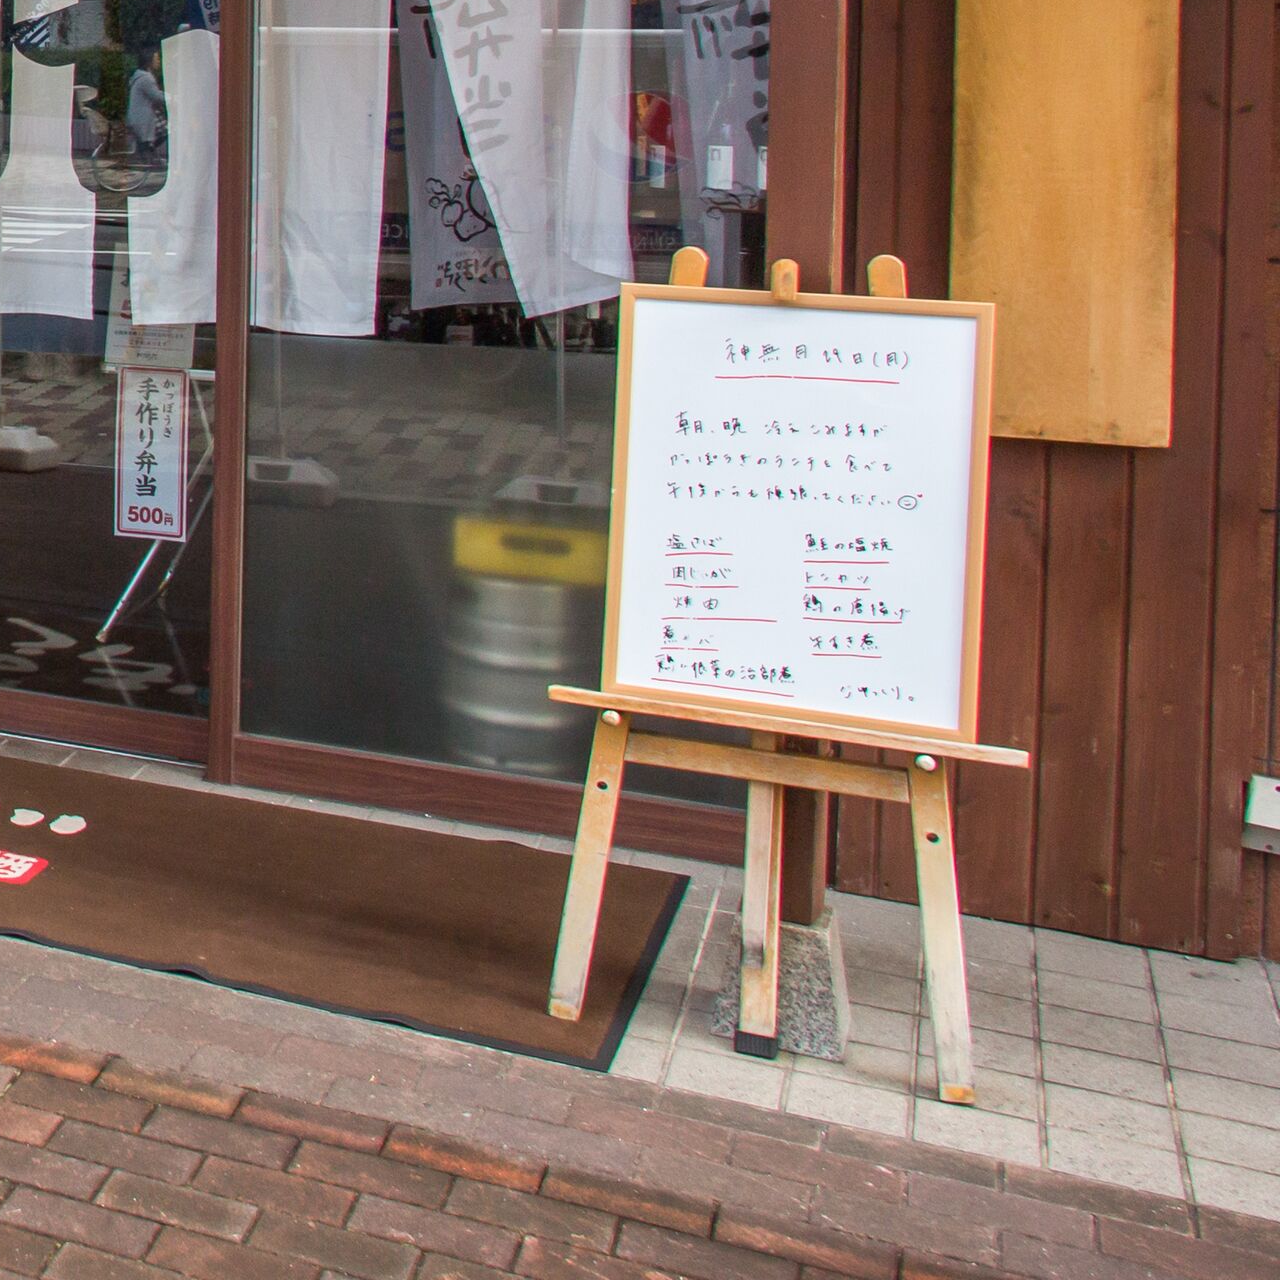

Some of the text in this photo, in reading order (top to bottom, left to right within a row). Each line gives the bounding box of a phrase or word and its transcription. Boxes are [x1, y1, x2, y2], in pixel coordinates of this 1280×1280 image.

[134, 376, 160, 498] 手作り弁当
[127, 505, 174, 527] 500円
